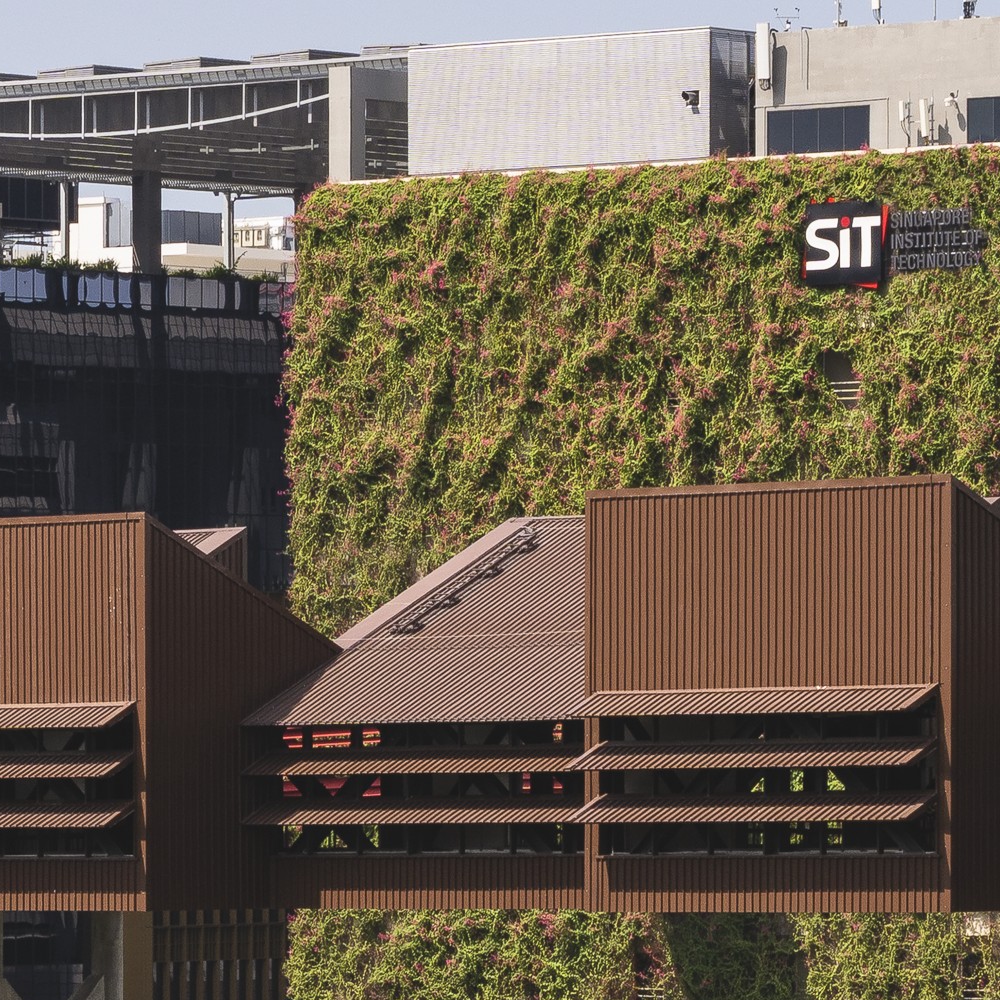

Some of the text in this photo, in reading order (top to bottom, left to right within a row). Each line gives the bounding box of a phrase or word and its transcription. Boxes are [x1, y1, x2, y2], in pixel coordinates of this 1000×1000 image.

[890, 208, 970, 229] SINGAPORE
[890, 229, 983, 249] INSTITUTE OF
[890, 251, 981, 270] TECHNOLOGY
